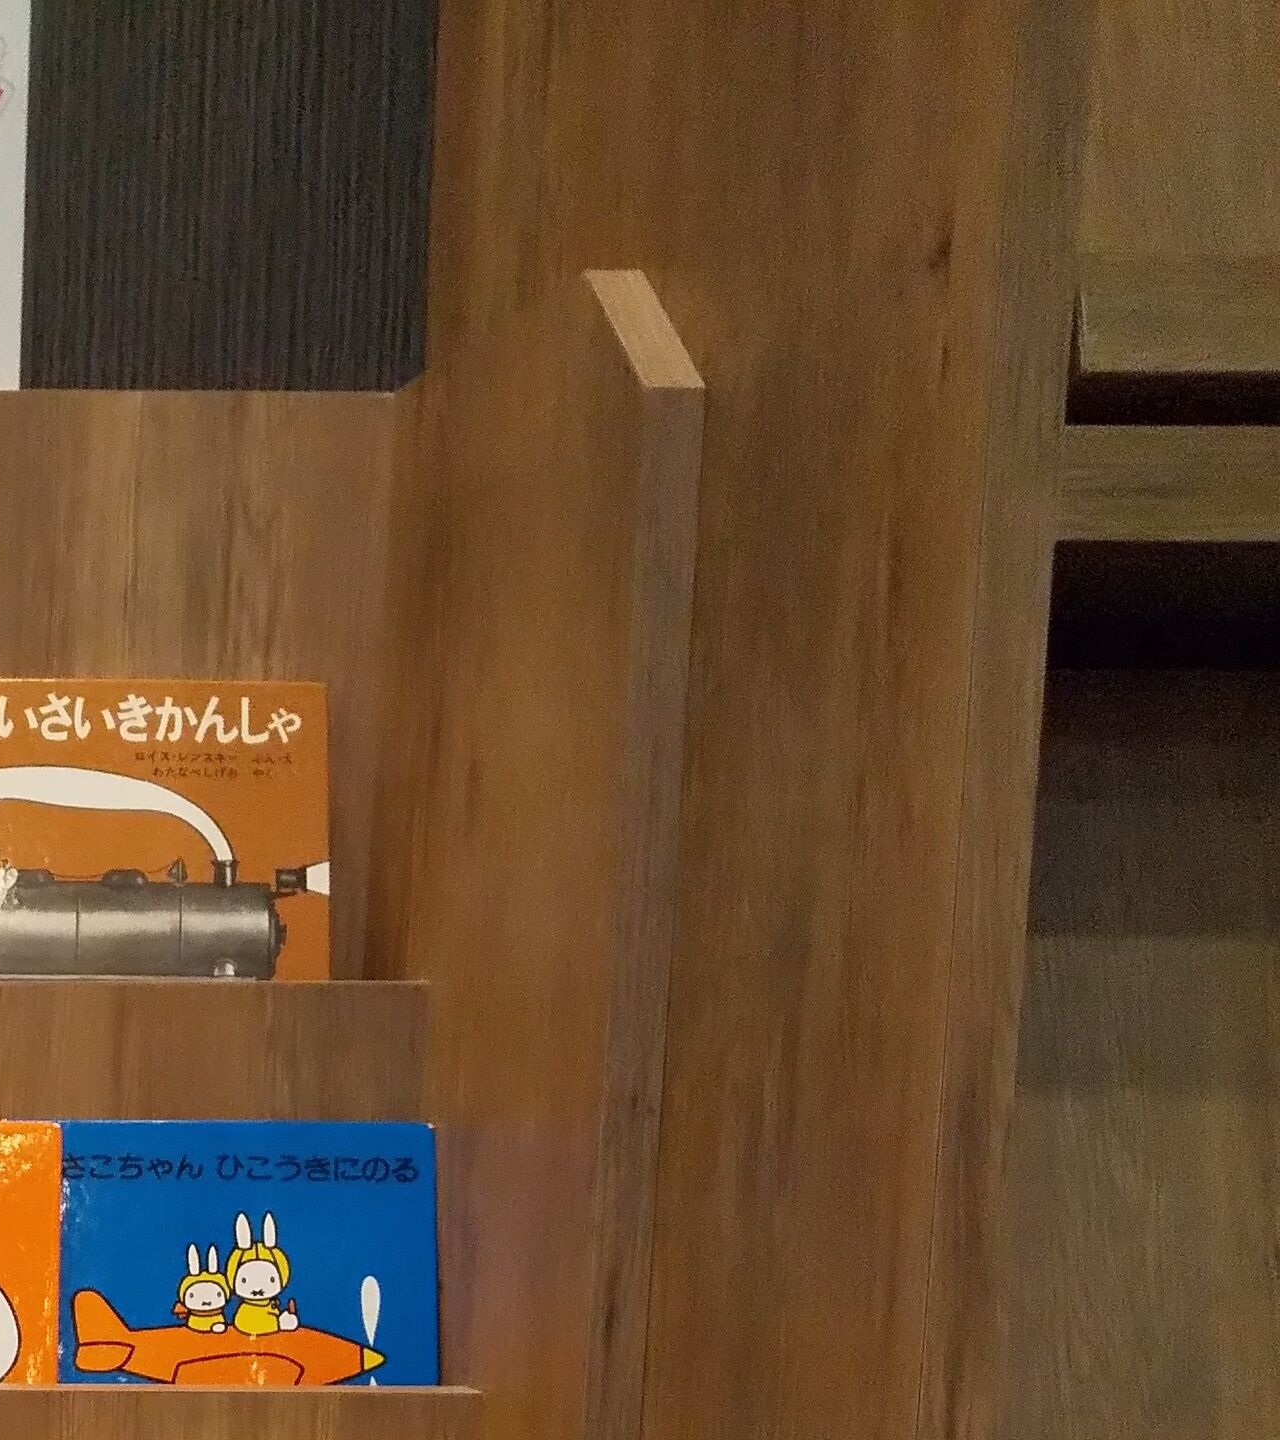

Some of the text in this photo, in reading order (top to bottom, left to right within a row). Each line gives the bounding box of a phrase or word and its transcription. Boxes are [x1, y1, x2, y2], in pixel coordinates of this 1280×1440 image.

[215, 1153, 420, 1185] ひこうきにのる
